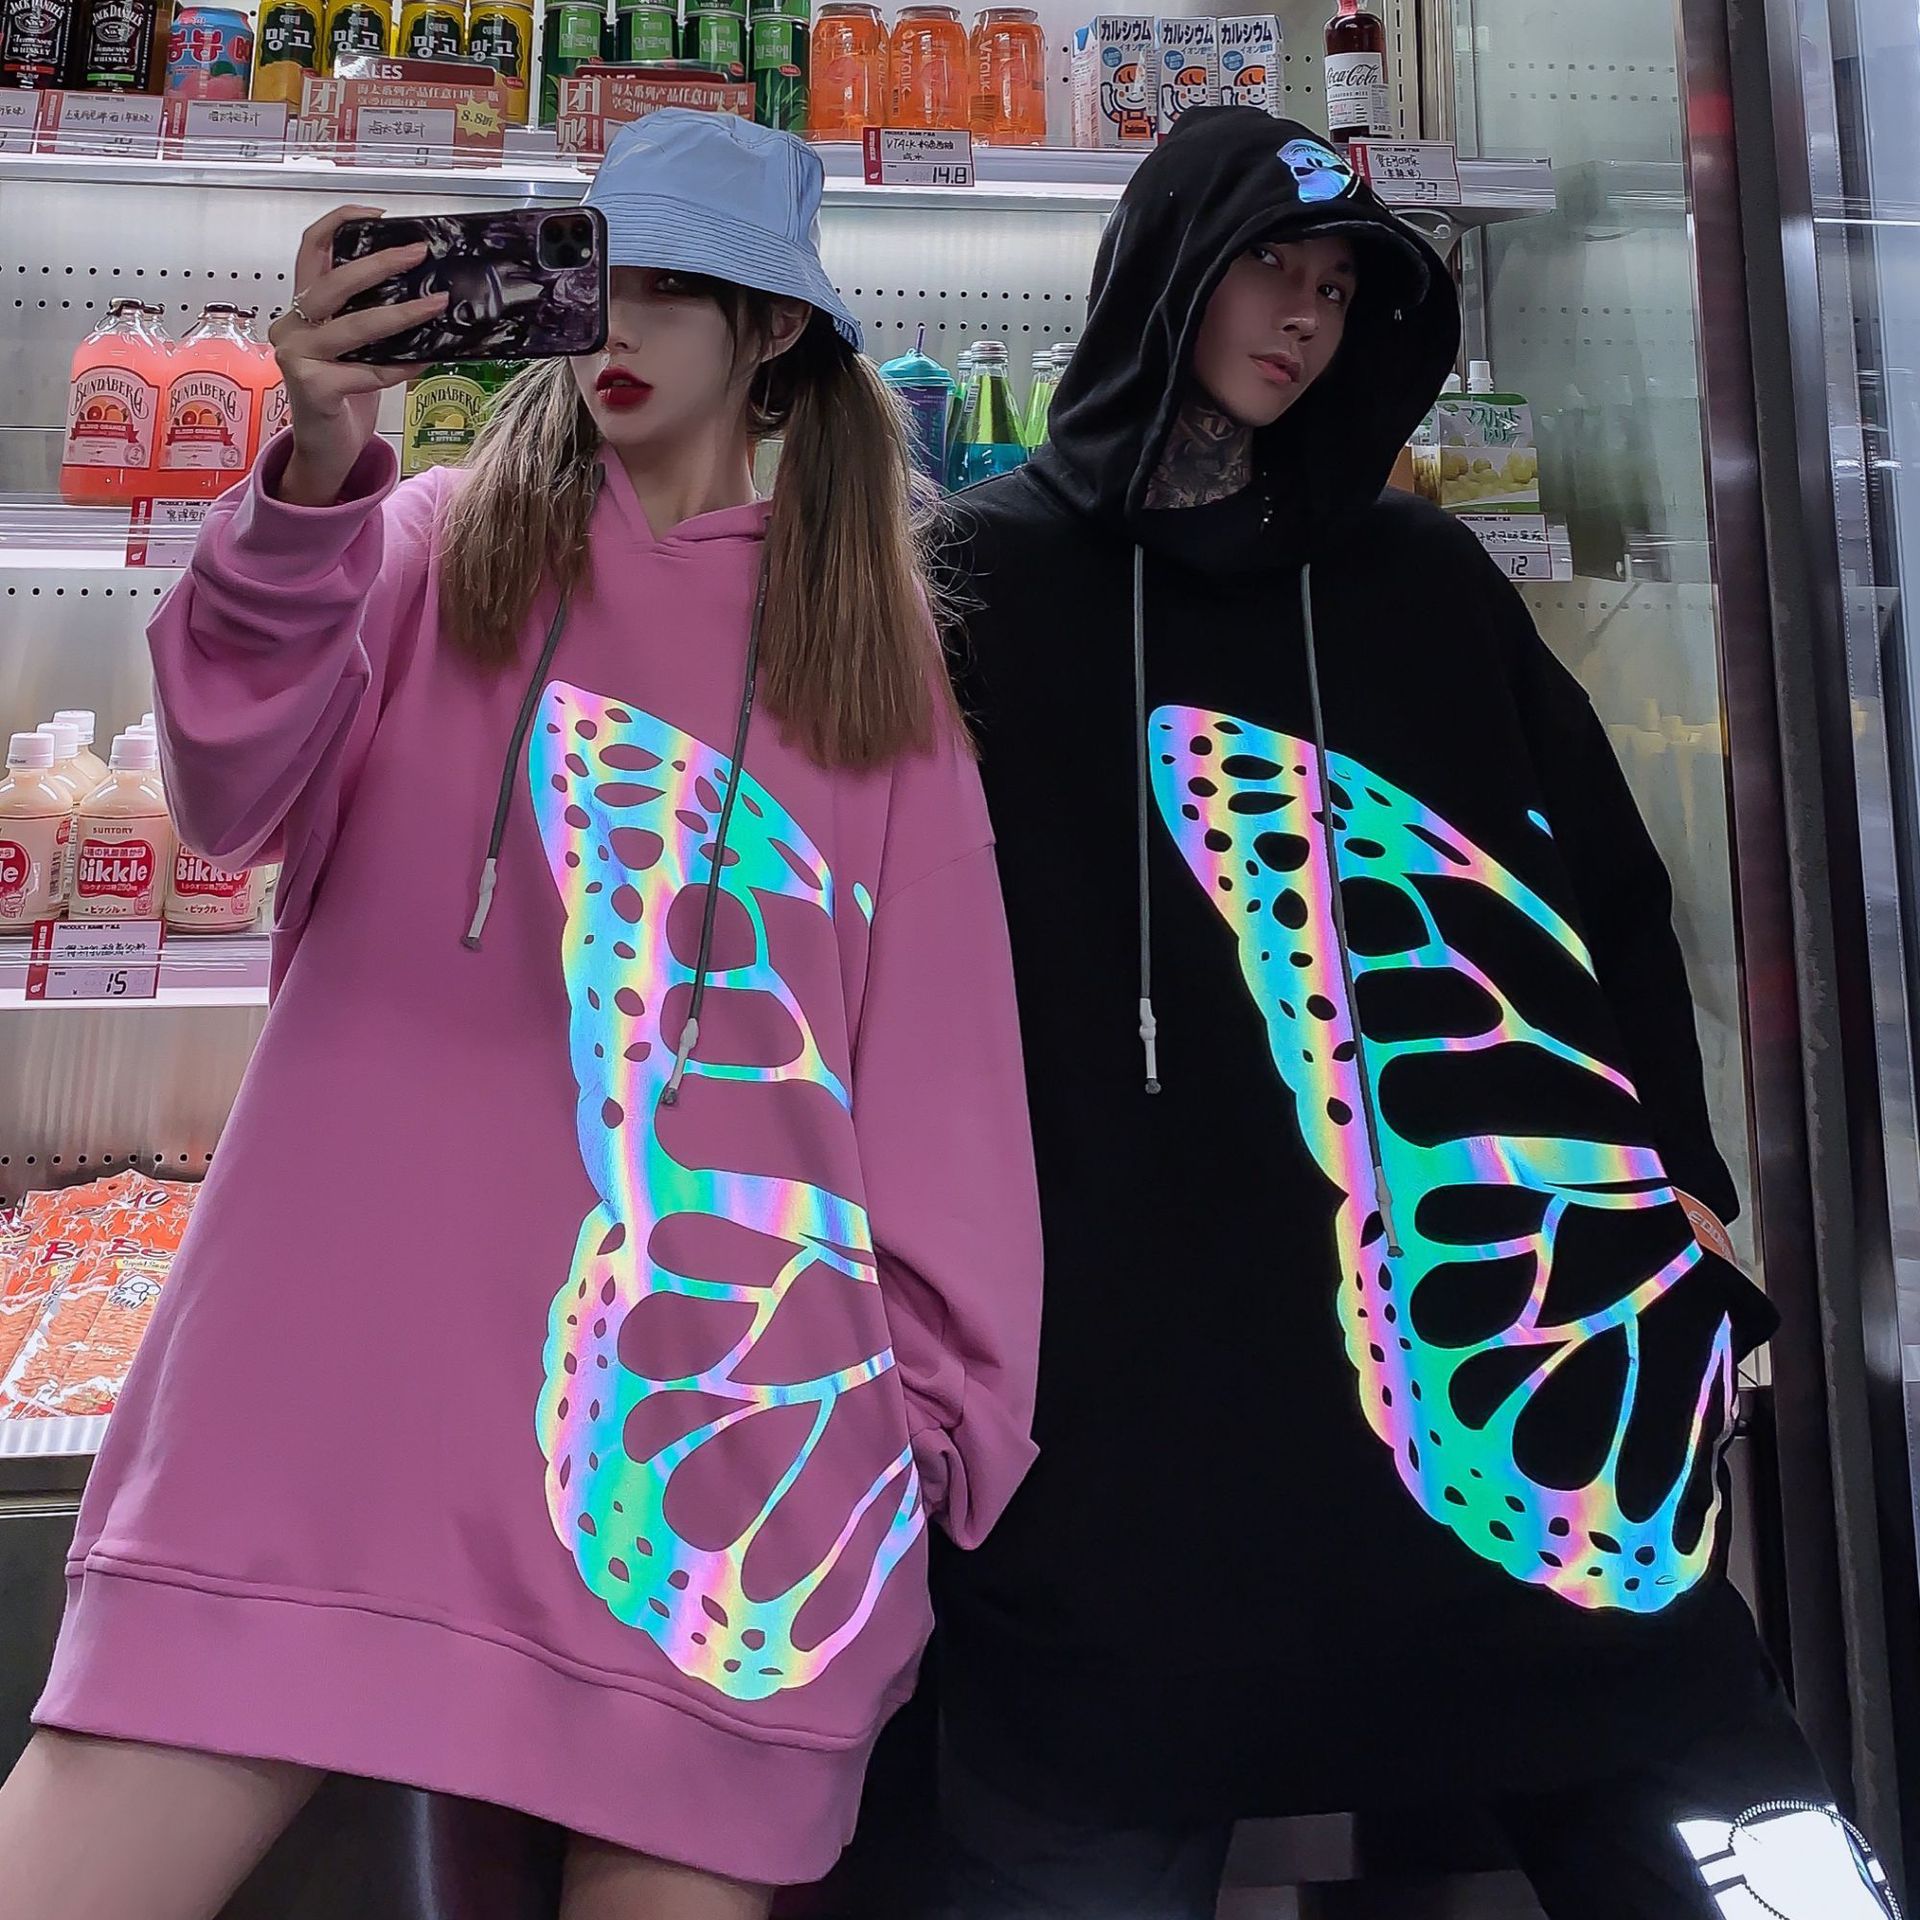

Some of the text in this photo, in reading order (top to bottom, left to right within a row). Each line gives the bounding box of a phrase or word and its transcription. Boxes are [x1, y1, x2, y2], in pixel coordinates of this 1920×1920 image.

[265, 28, 313, 52] 망고
[333, 29, 380, 52] 망고
[1101, 20, 1152, 43] カルシウム
[1163, 23, 1215, 45] カルシウム
[1221, 21, 1273, 45] カルシウム
[413, 35, 459, 59] 망고
[471, 39, 515, 63] 망고
[932, 166, 967, 184] 14.8
[70, 375, 149, 420] BUNDABERG
[166, 380, 243, 422] BUNDABERG
[1511, 556, 1528, 576] 12
[92, 827, 133, 835] SUNTORY
[79, 858, 148, 883] Bikkle
[106, 970, 128, 995] 15
